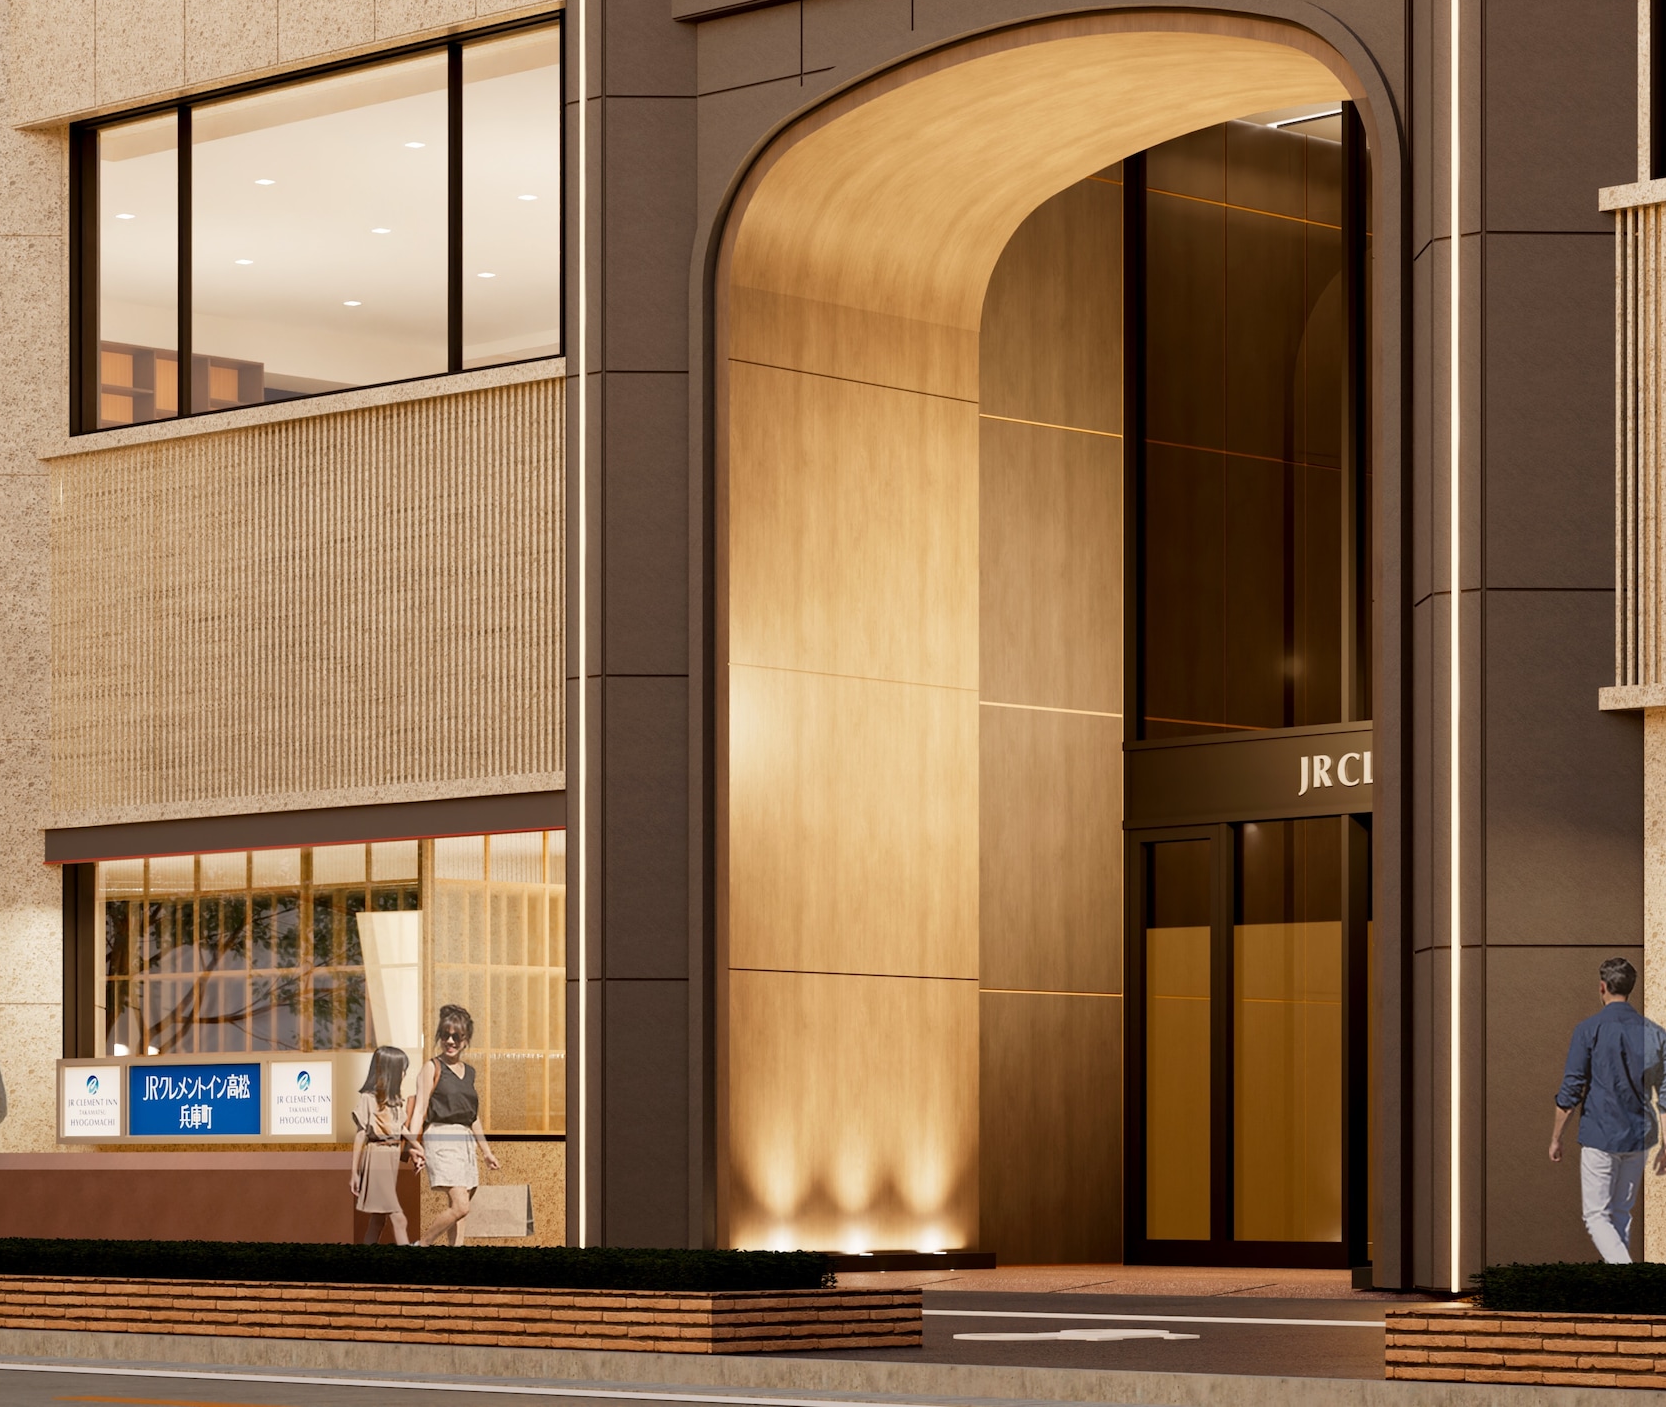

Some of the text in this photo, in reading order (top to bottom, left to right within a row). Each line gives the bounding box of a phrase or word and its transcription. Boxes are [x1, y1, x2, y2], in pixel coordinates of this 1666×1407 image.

[142, 1073, 251, 1101] JRクレメントイン高松
[76, 1098, 104, 1107] CLEMENT
[105, 1098, 118, 1106] INN
[285, 1094, 316, 1103] CLEMENT
[317, 1094, 331, 1103] INN
[179, 1103, 213, 1129] 兵庫町
[279, 1115, 329, 1125] HYOGOMACHI
[70, 1118, 116, 1127] HYOGOMACHI
